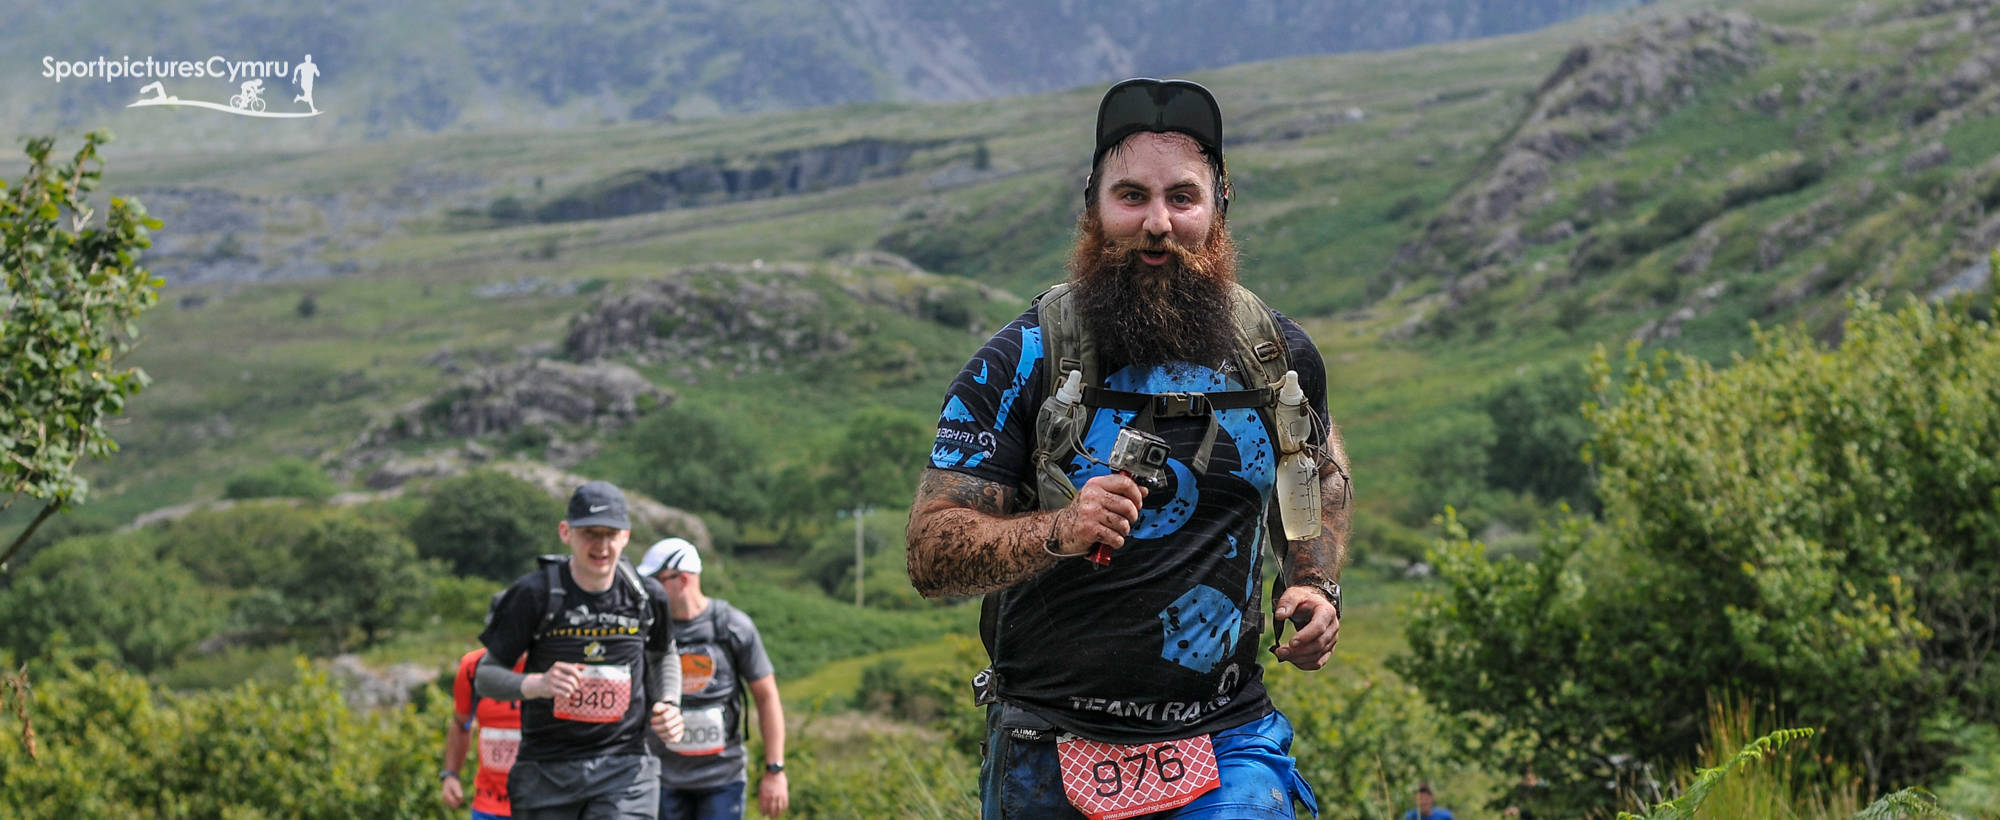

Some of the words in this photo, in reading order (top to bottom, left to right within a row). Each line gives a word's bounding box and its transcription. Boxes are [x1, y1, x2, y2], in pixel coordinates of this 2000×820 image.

[959, 431, 976, 443] FIT
[569, 689, 616, 710] 940
[1069, 696, 1156, 720] TEAM
[1093, 744, 1185, 798] 976
